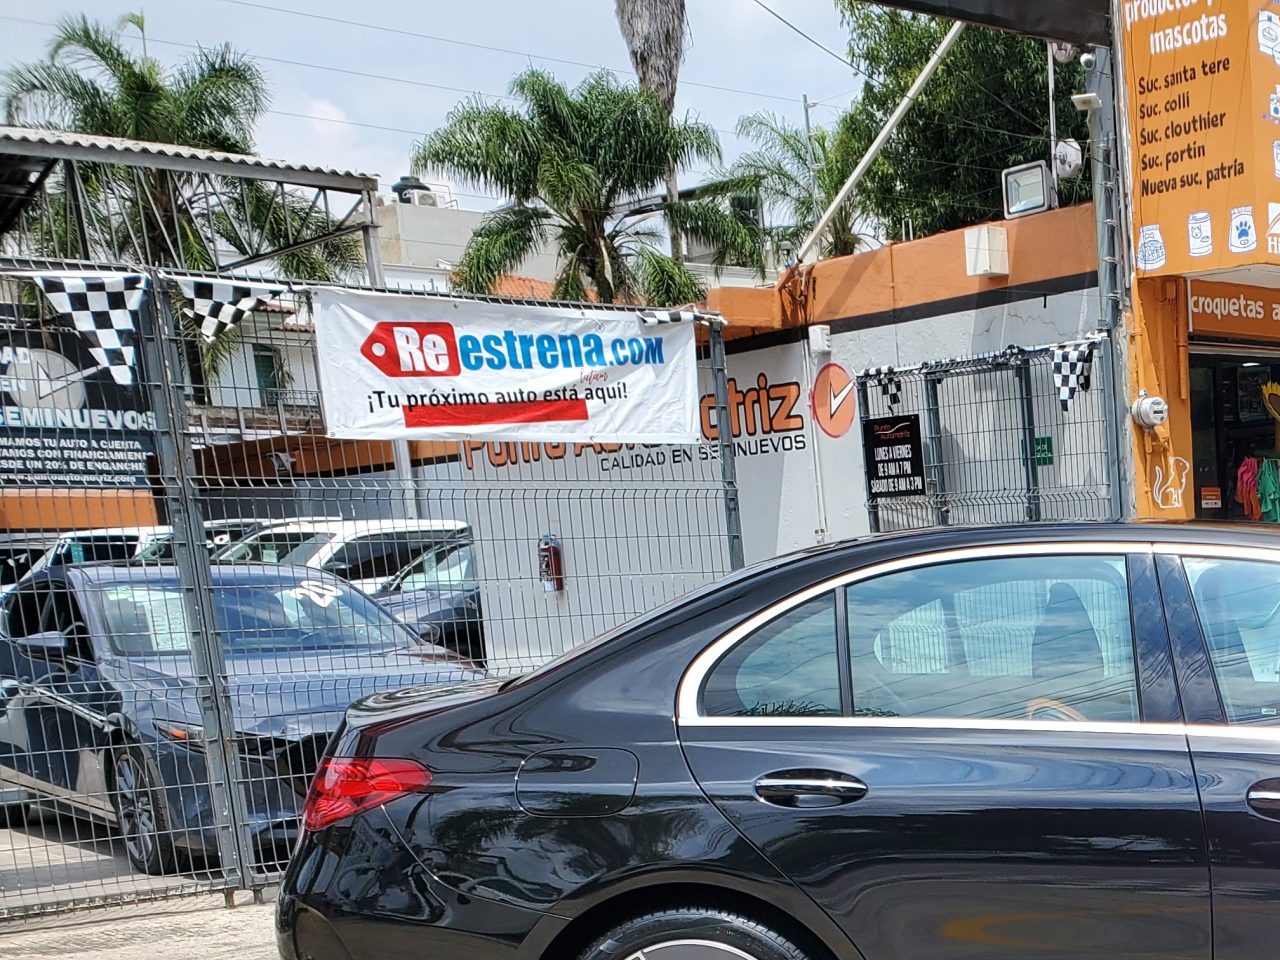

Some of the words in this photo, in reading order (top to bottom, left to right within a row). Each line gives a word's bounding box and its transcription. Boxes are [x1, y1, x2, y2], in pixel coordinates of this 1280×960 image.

[1150, 13, 1228, 55] mascotas
[1138, 76, 1162, 95] Suc.
[1164, 65, 1196, 89] santa
[1201, 57, 1230, 76] tere
[1139, 103, 1161, 120] Suc.
[1140, 128, 1162, 146] Suc.
[1164, 111, 1226, 140] clouthier
[1141, 153, 1163, 171] Suc.
[1141, 177, 1177, 197] Nueva
[1180, 172, 1202, 188] suc.
[1206, 158, 1244, 189] patria
[1191, 294, 1265, 320] croquetas
[1272, 304, 1280, 321] a
[367, 390, 401, 414] ¡Tu
[406, 388, 489, 413] próximo
[496, 388, 538, 405] auto
[543, 384, 579, 402] está
[585, 382, 628, 404] aquí!
[37, 450, 62, 459] CON
[43, 439, 57, 448] TU
[59, 440, 88, 449] AUTO
[100, 441, 142, 450] CUENTA
[893, 444, 912, 459] VIERNES
[26, 461, 43, 469] UN
[70, 463, 84, 471] DE
[86, 463, 146, 472] ENGANCHE
[601, 453, 666, 471] CALIDAD
[672, 448, 693, 464] EN
